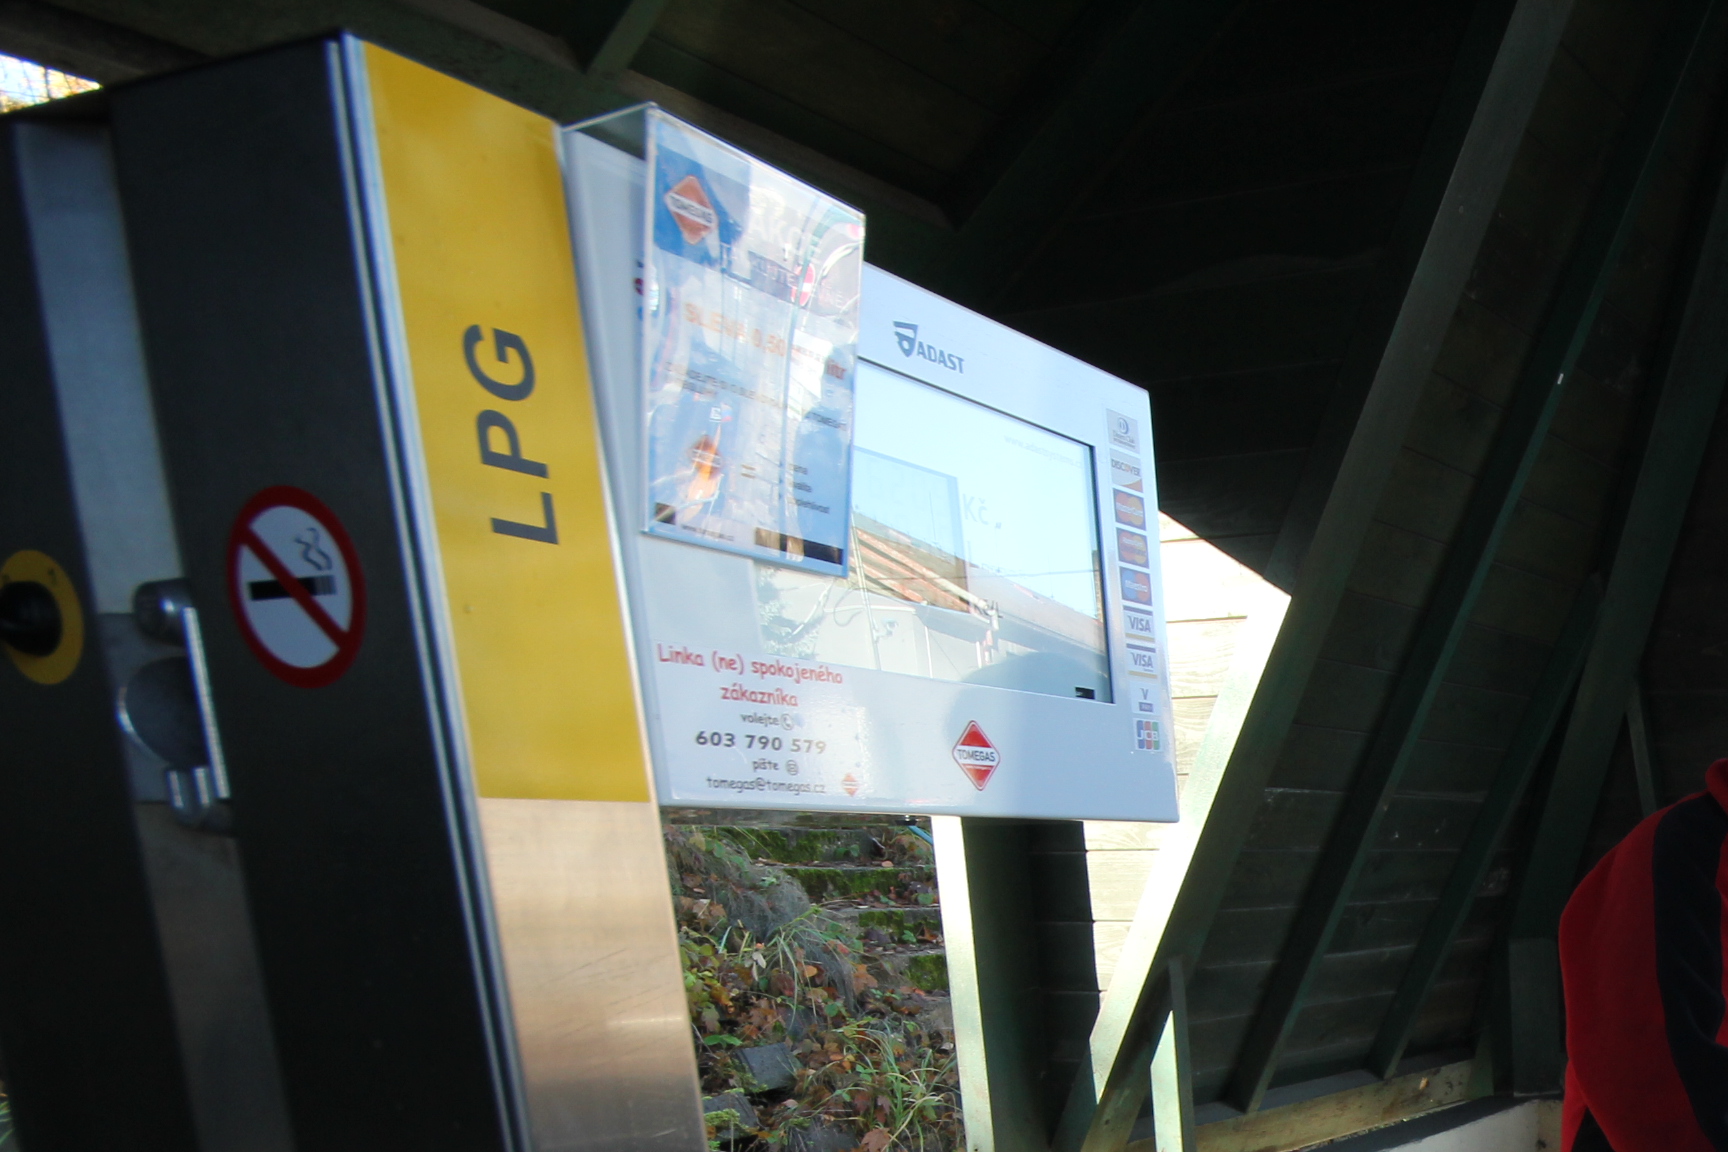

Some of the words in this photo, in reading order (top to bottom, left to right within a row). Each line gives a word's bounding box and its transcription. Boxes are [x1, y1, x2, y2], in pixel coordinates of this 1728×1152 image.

[917, 341, 965, 374] ADAST
[464, 324, 560, 545] LPG
[963, 493, 989, 525] Kč
[1127, 615, 1152, 633] VISA
[657, 643, 704, 666] Linka
[711, 650, 745, 676] (ne)
[752, 659, 843, 685] spokojeného
[1130, 652, 1154, 669] VISA
[720, 683, 799, 707] zákazníka
[740, 713, 780, 728] volejte
[695, 730, 736, 748] 603
[744, 733, 783, 751] 790
[790, 738, 828, 754] 579
[956, 748, 997, 762] TOMEGAS
[706, 776, 827, 796] tomegas@tomegas.cz
